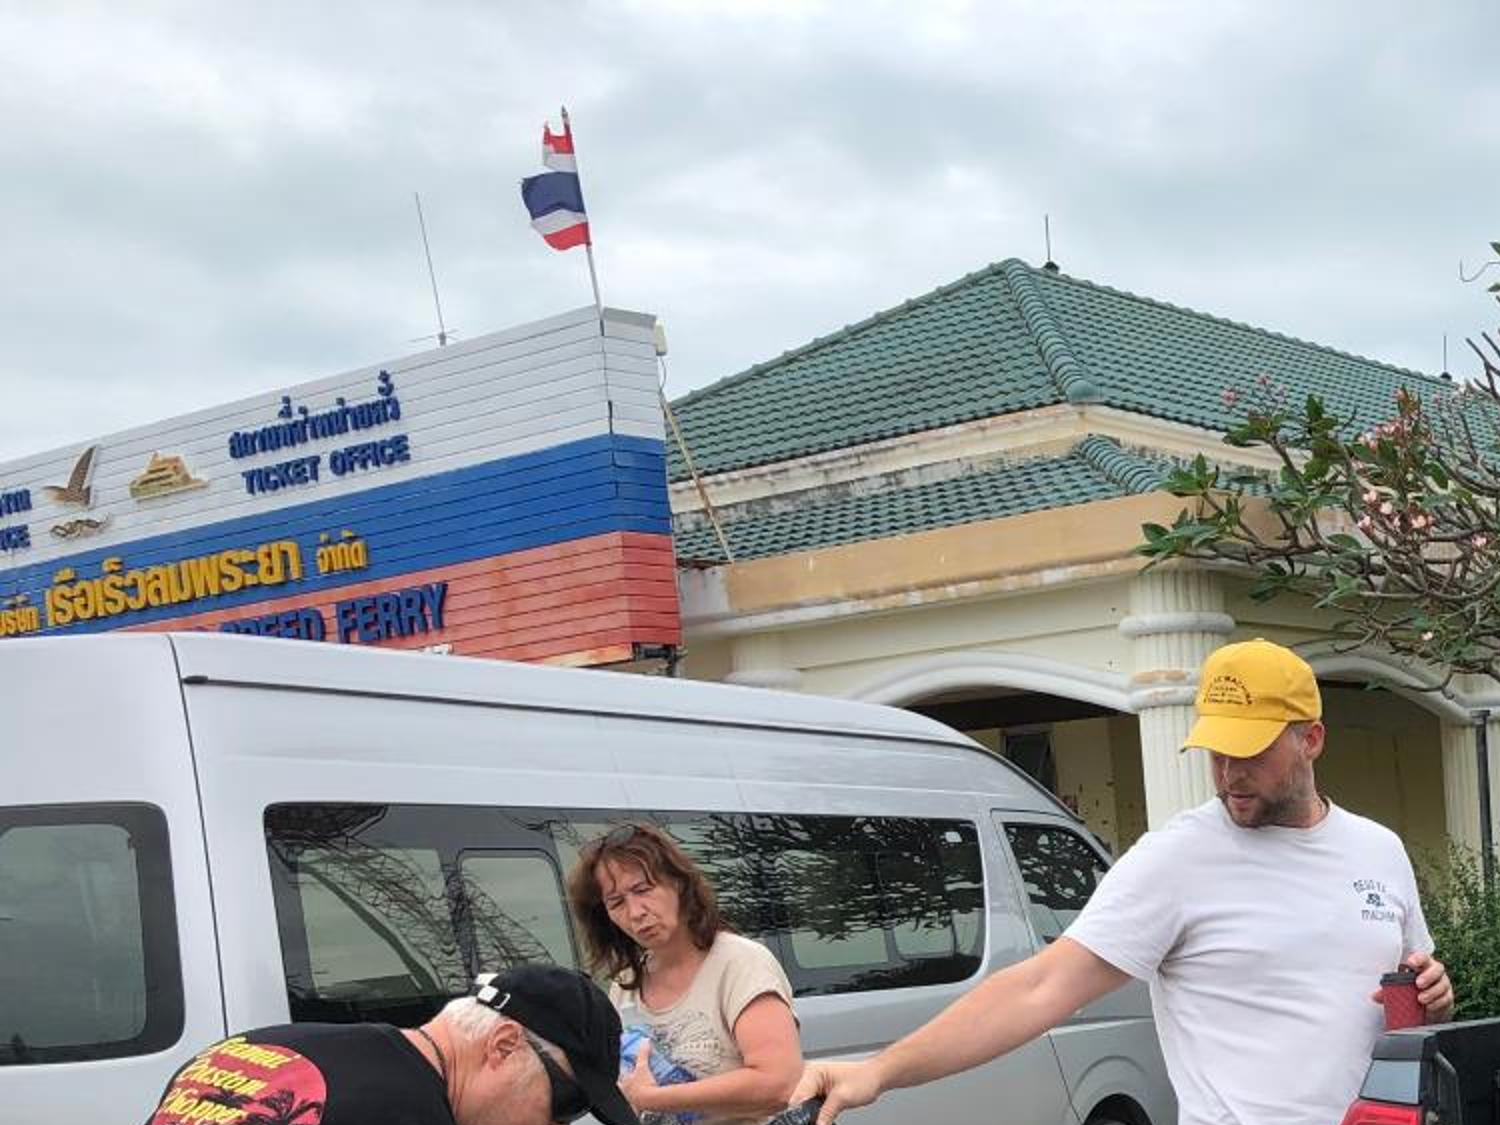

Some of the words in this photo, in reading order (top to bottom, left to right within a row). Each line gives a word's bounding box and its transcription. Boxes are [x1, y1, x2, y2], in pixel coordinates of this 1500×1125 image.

[241, 455, 321, 496] TICKET
[329, 433, 412, 477] OFFICE
[43, 540, 303, 627] เรือเร็วลมพระยา
[316, 529, 369, 574] จำกัด
[334, 580, 449, 644] FERRY
